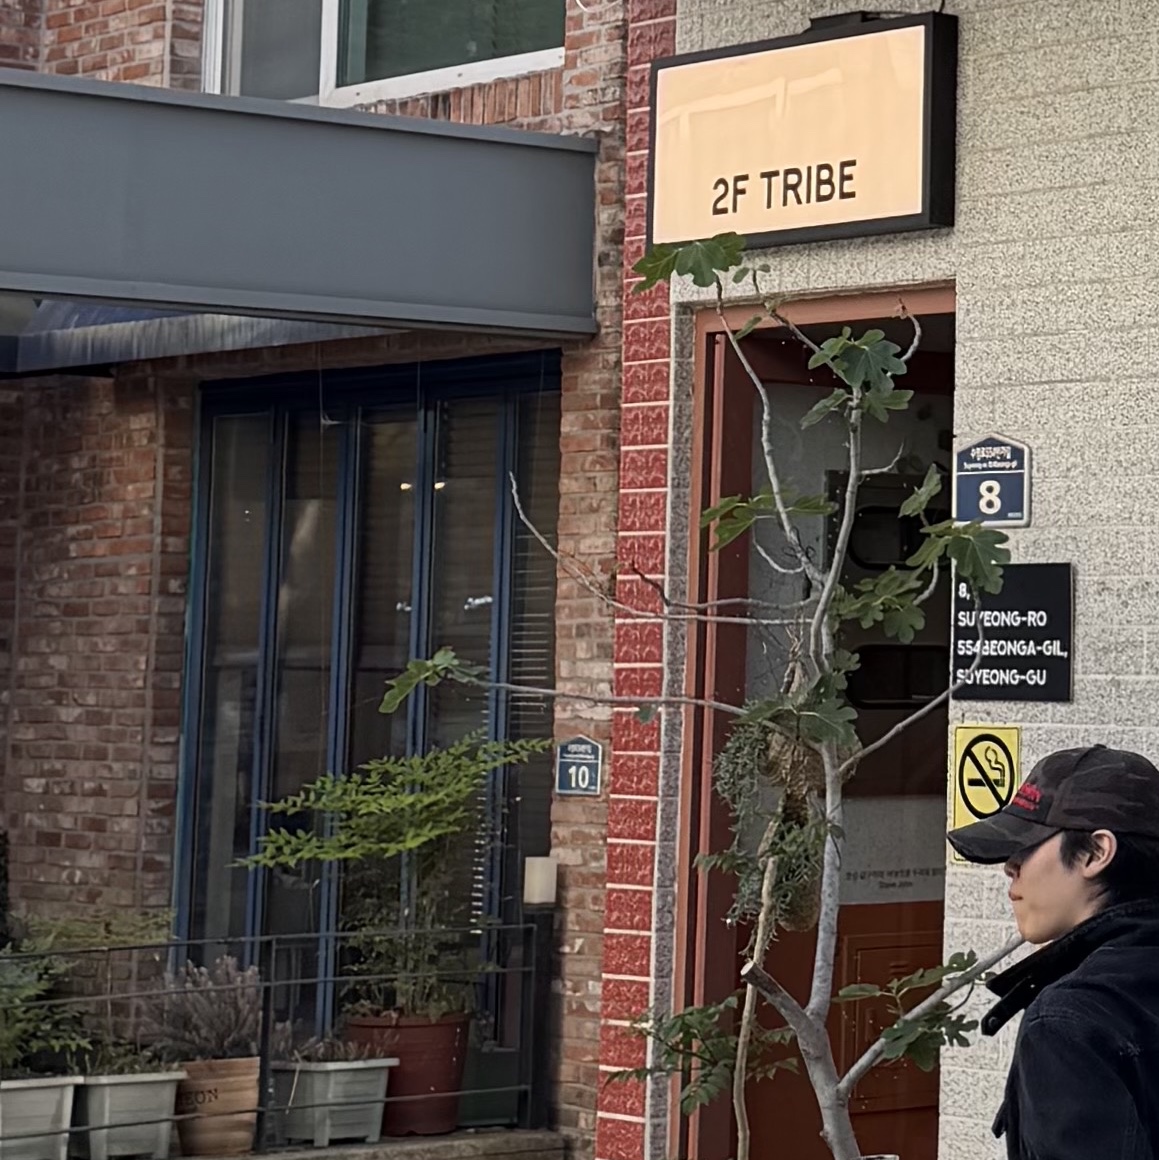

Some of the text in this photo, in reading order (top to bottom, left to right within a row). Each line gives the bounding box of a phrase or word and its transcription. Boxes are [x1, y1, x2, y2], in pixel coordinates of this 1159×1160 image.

[712, 159, 857, 215] 2F TRIBE
[979, 480, 1002, 514] 8
[958, 582, 971, 600] 8,
[568, 765, 589, 788] 10
